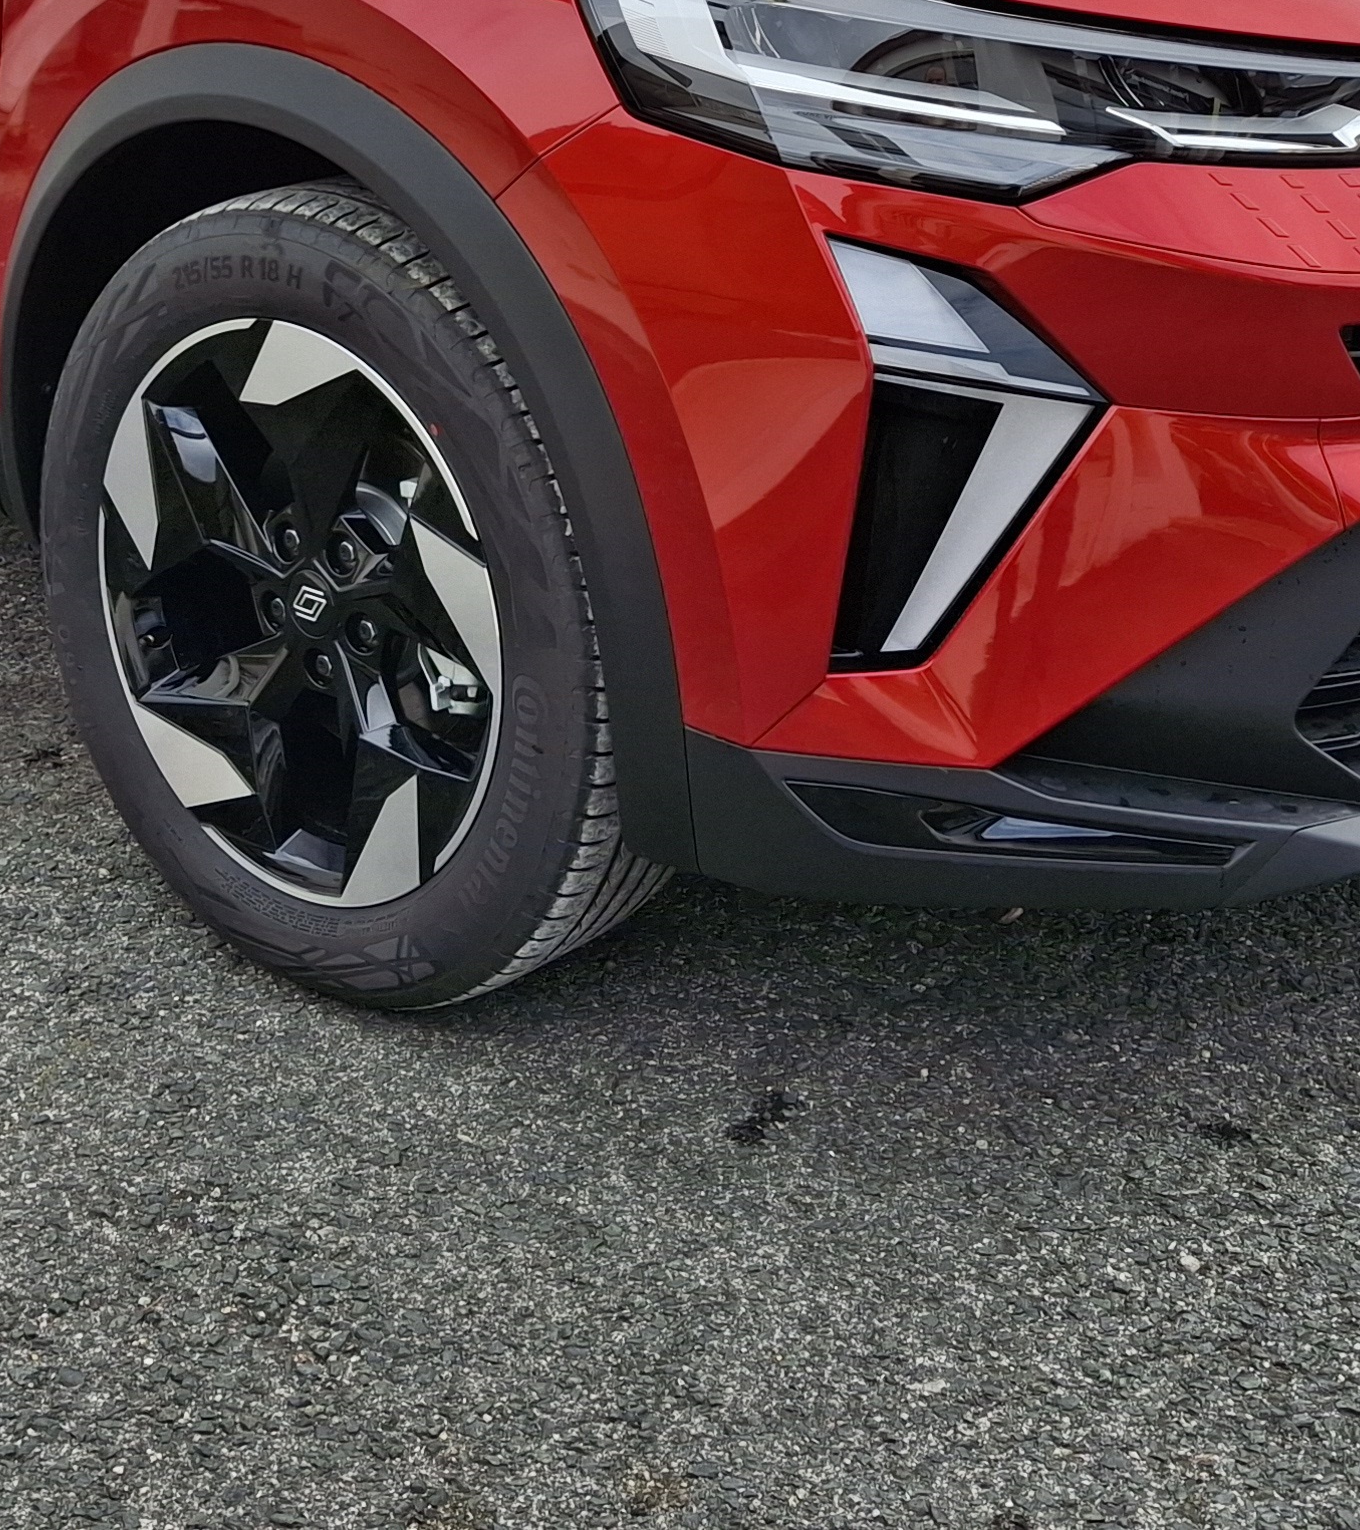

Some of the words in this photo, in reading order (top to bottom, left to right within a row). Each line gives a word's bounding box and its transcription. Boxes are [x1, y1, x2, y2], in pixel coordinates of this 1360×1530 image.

[240, 257, 255, 279] R
[259, 259, 280, 283] 18
[286, 264, 304, 290] H
